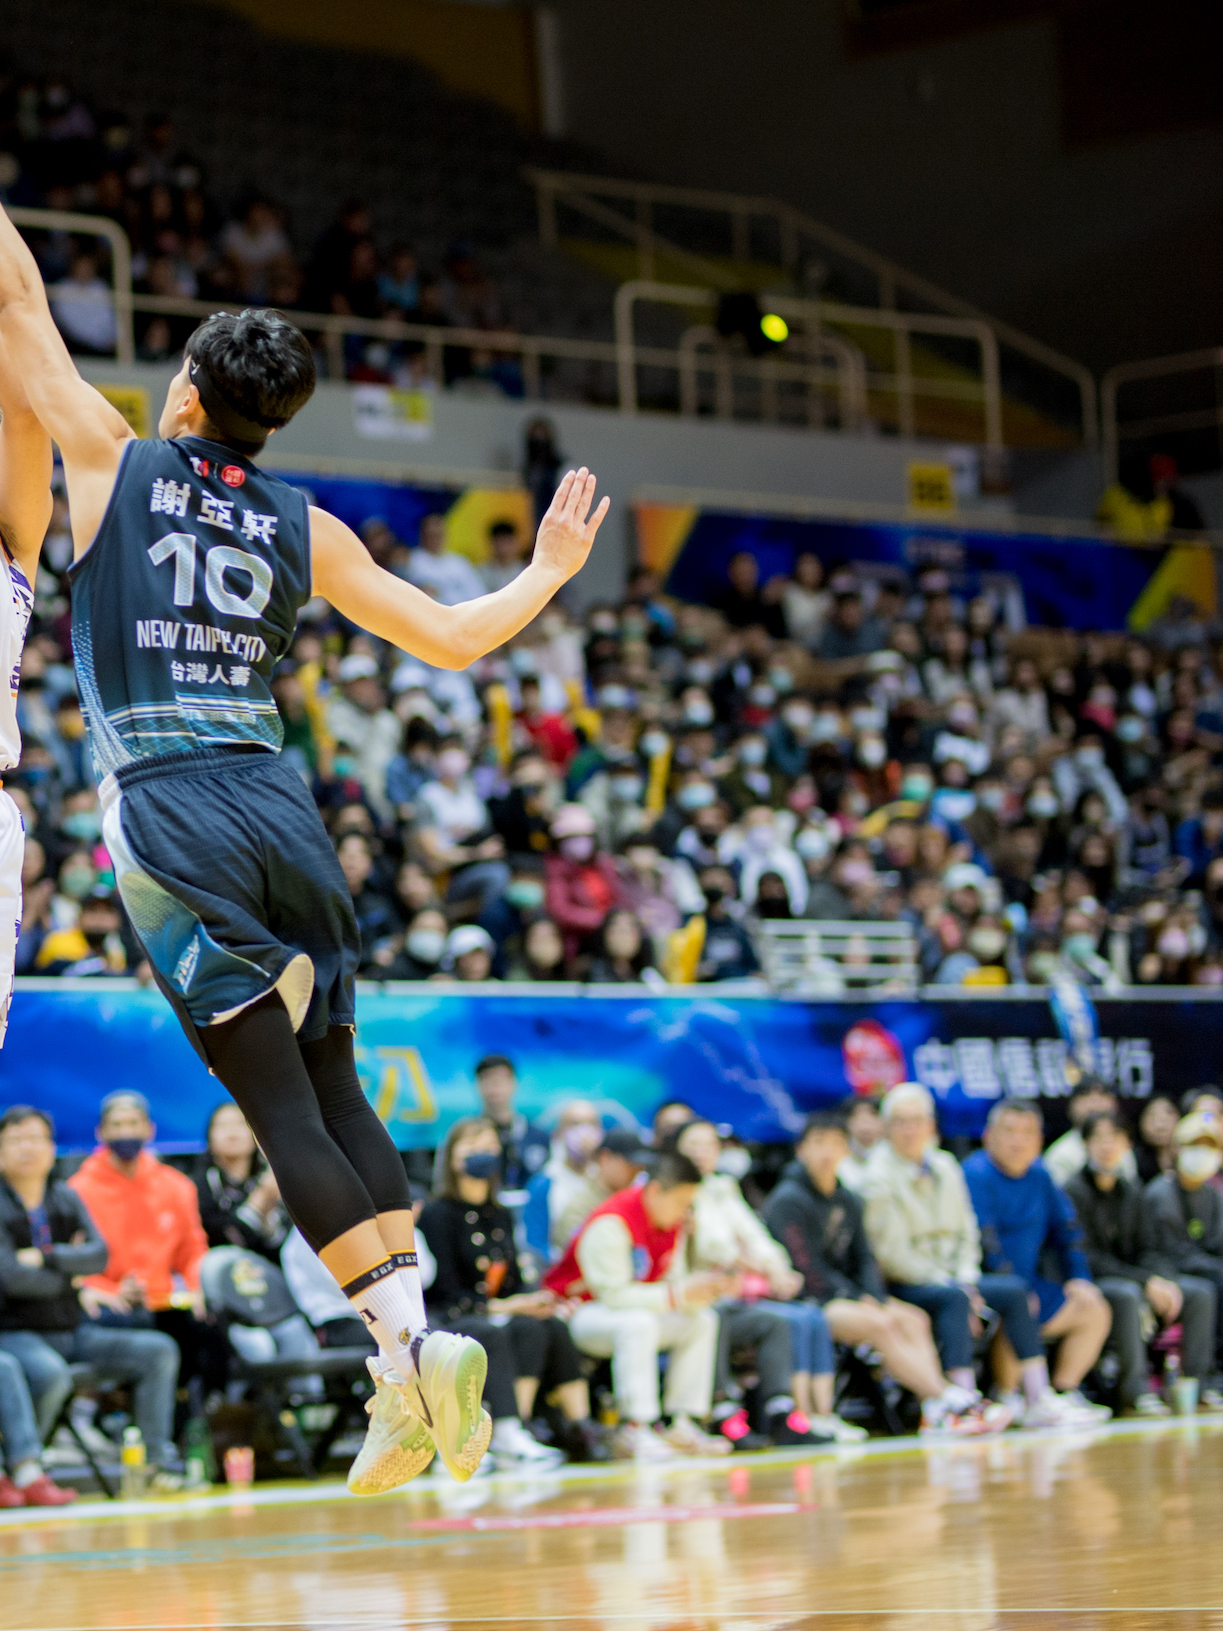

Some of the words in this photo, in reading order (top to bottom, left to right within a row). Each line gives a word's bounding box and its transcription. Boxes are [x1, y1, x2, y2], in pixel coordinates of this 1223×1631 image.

[150, 477, 278, 545] 謝亞軒
[147, 531, 274, 619] 10
[136, 619, 181, 649] NEW
[170, 660, 251, 687] 台灣人壽
